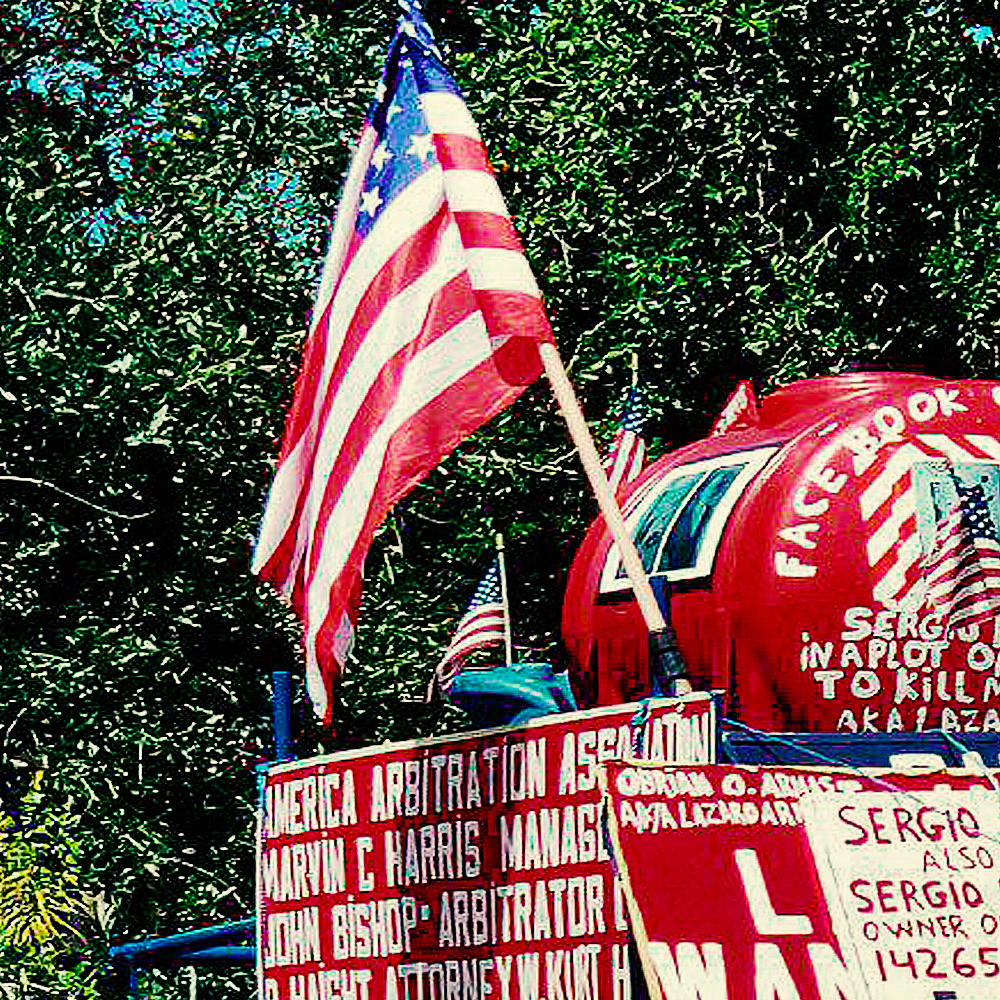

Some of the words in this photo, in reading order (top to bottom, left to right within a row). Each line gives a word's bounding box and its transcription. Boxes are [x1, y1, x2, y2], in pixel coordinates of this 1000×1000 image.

[867, 638, 950, 670] PLOT
[813, 669, 882, 700] TO
[836, 706, 906, 734] AKA
[838, 804, 982, 846] SERGIO
[922, 846, 995, 873] ALSO
[733, 848, 814, 935] L
[849, 878, 983, 914] SERGIO
[862, 914, 968, 943] OWNER
[875, 947, 1000, 983] 14265
